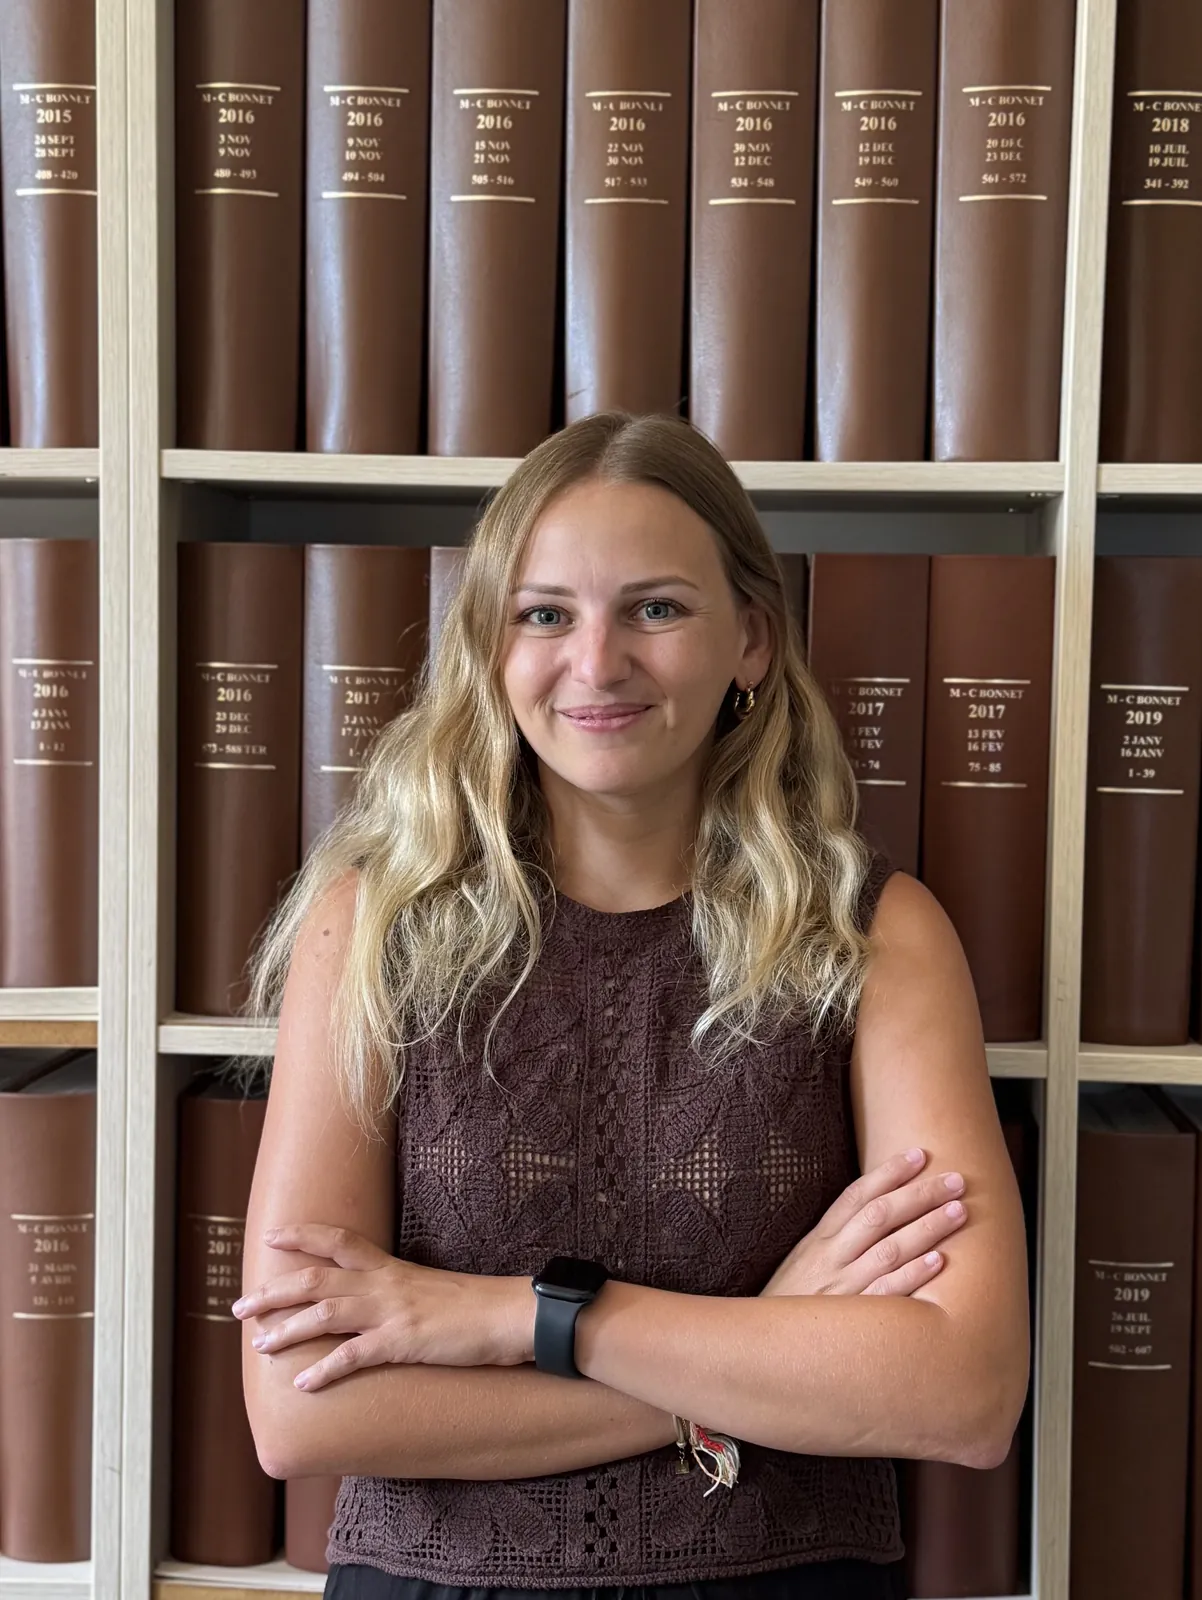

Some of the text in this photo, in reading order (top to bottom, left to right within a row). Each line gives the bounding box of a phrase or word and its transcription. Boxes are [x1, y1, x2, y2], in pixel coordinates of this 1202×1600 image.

[46, 94, 91, 104] BONNET
[228, 92, 273, 105] BONNET
[357, 96, 401, 108] BONNET
[999, 96, 1044, 106] BONNET
[486, 99, 531, 110] BONNET
[620, 101, 663, 112] BONNET
[746, 101, 790, 111] BONNET
[870, 100, 915, 111] BONNET
[1163, 101, 1202, 112] BONNE
[36, 109, 72, 123] 2015
[218, 108, 255, 124] 2016
[347, 111, 383, 127] 2016
[988, 112, 1025, 127] 2016
[476, 114, 512, 129] 2016
[609, 117, 646, 131] 2016
[736, 117, 772, 132] 2016
[860, 116, 897, 131] 2016
[1152, 117, 1190, 133] 2018
[47, 135, 74, 145] SEPT
[218, 134, 251, 144] 3 NOV
[347, 137, 380, 148] 9 NOV
[986, 139, 1024, 148] 20 DEC
[475, 140, 511, 151] 15 NOV
[607, 143, 644, 153] 22 NOV
[733, 143, 771, 153] 30 NOV
[859, 143, 894, 152] 12 DEC
[1149, 144, 1190, 154] 10 JUIL
[47, 148, 75, 158] SEPT
[218, 147, 251, 157] 9 NOV
[345, 150, 382, 160] 10 NOV
[986, 152, 1022, 162] 23 DEC
[474, 154, 510, 164] 21 NOV
[606, 156, 643, 166] 30 NOV
[734, 156, 772, 166] 12 DEC
[859, 156, 894, 166] 19 DEC
[1148, 157, 1189, 168] 19 JUIL
[60, 170, 78, 179] 420
[239, 169, 257, 179] 493
[342, 172, 385, 182] 494 504
[982, 173, 1027, 184] 561 572
[496, 176, 514, 185] 516
[604, 177, 621, 187] 517
[730, 177, 774, 187] 534 548
[854, 177, 899, 187] 549 560
[1144, 178, 1189, 189] 341 392
[227, 673, 270, 683] BONNET
[33, 683, 69, 698] 2016
[217, 687, 252, 702] 2016
[858, 687, 904, 696] BONNET
[980, 689, 1024, 699] BONNET
[345, 691, 380, 705] 2017
[1136, 695, 1181, 706] BONNET
[848, 702, 885, 716] 2017
[968, 704, 1005, 719] 2017
[215, 712, 251, 722] 23 DEC
[1126, 710, 1162, 726] 2019
[215, 724, 252, 734] 29 DEC
[341, 727, 352, 736] 17
[858, 727, 880, 736] FEV
[967, 729, 1004, 739] 13 FEV
[861, 740, 883, 749] FEV
[1123, 735, 1162, 745] 2 JANV
[243, 745, 267, 755] TER
[967, 742, 1004, 752] 16 FEV
[1121, 748, 1164, 758] 16 JANV
[868, 760, 880, 770] 74
[968, 762, 1001, 772] 75 85
[1142, 768, 1156, 778] 39
[34, 1239, 70, 1253] 2016
[207, 1241, 242, 1255] 2017
[1124, 1272, 1167, 1282] BONNET
[1114, 1287, 1150, 1302] 2019
[1125, 1312, 1151, 1322] JUIL
[1124, 1325, 1151, 1335] SEPT
